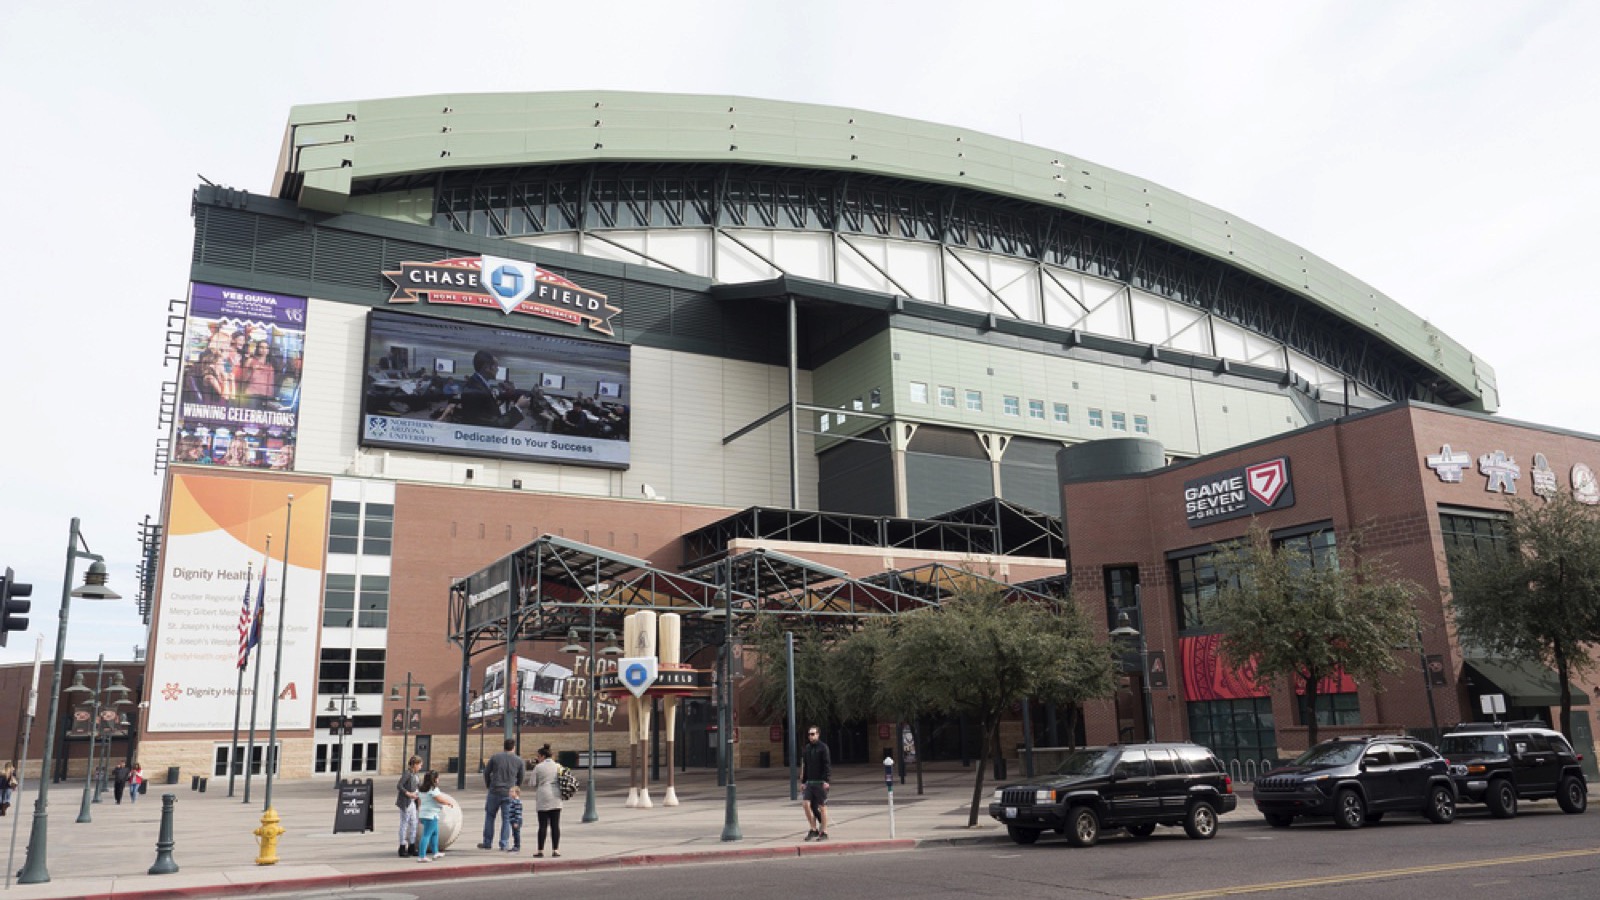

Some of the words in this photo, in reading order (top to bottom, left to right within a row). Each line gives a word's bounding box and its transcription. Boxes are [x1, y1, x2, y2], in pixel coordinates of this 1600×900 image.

[222, 290, 244, 300] VEE
[409, 269, 478, 286] CHASE
[538, 285, 600, 311] FIELD
[433, 293, 457, 301] HOME
[477, 296, 494, 304] THE
[183, 402, 227, 420] WINNING
[228, 407, 295, 427] CELEBRATIONS
[390, 419, 433, 429] NORTHERN
[391, 425, 425, 435] ARIZONA
[389, 432, 435, 443] UNIVERSITY
[454, 430, 508, 445] Dedicated
[511, 436, 521, 446] to
[524, 437, 548, 448] Your
[550, 439, 593, 454] Success
[1256, 469, 1276, 492] 7
[1185, 476, 1243, 501] GAME
[1186, 489, 1246, 513] SEVEN
[1196, 504, 1237, 518] GRILL
[172, 567, 214, 581] Dignity
[171, 592, 203, 600] Chandler
[204, 593, 236, 602] Regional
[169, 607, 191, 616] Mercy
[658, 675, 692, 683] FIELD
[186, 687, 221, 698] Dignity
